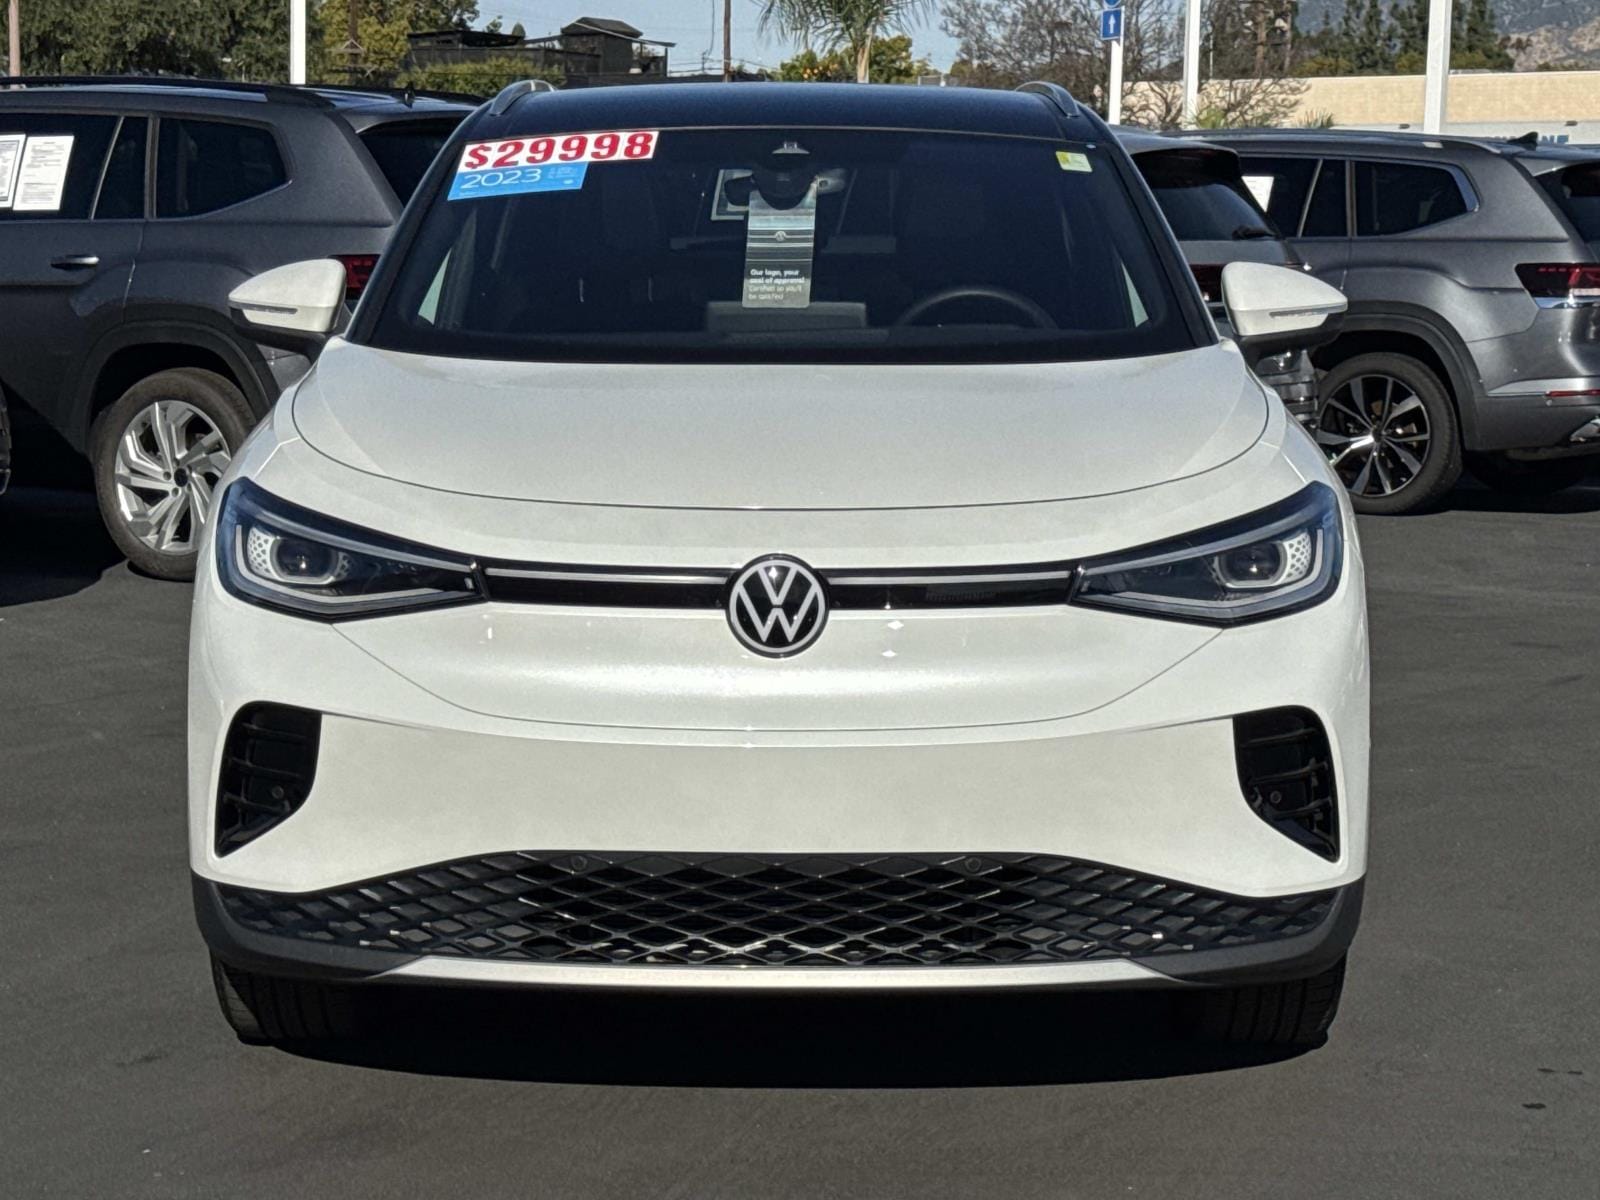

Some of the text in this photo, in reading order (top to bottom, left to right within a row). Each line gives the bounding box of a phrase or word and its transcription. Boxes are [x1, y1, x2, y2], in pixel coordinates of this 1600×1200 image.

[464, 132, 652, 169] $29998
[461, 168, 542, 189] 2023
[735, 563, 821, 645] VW
